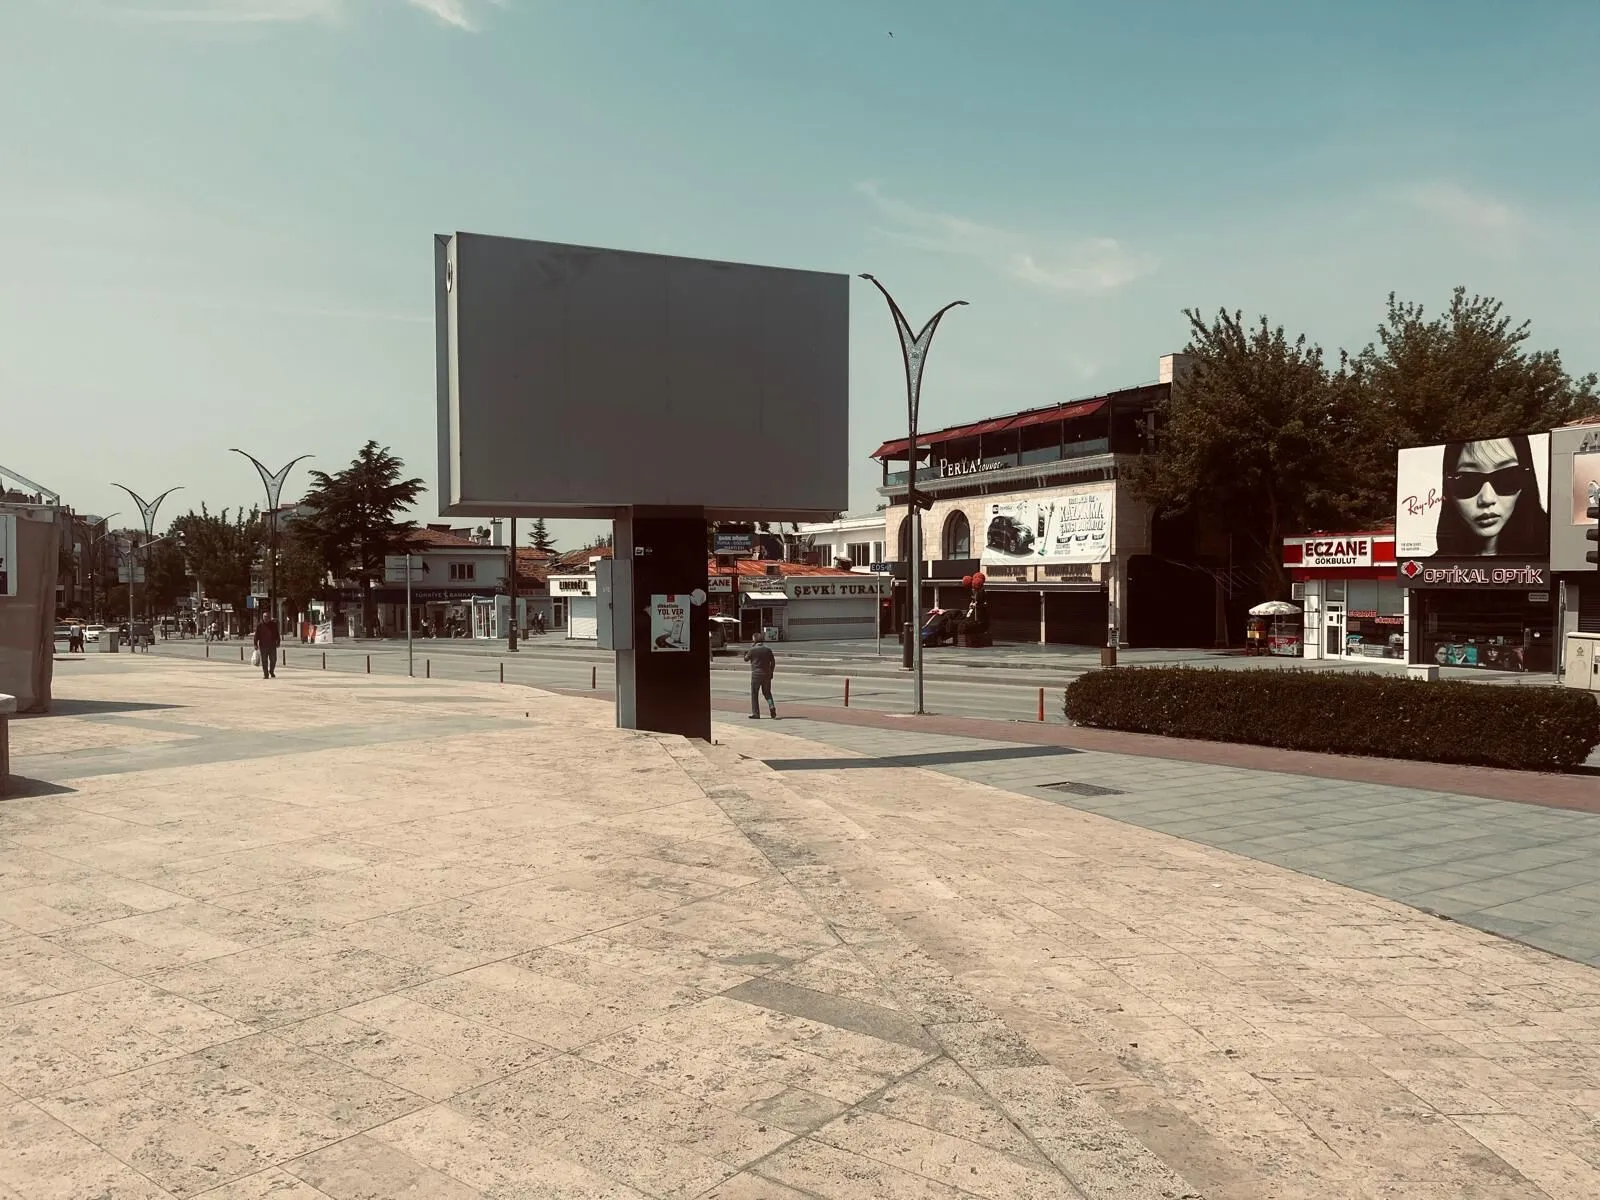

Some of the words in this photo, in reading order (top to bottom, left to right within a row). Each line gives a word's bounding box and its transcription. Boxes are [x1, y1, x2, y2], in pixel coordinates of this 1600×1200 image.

[940, 458, 977, 477] PERLA
[1402, 488, 1446, 515] Ray-Ban
[1305, 541, 1367, 557] ECZANE
[708, 578, 730, 586] ZANE
[1424, 565, 1490, 584] OPTİKAL
[1492, 565, 1543, 584] OPTİK
[794, 584, 835, 598] ŞEVKİ
[840, 584, 884, 594] TURAK
[658, 608, 670, 616] YOL
[672, 608, 684, 616] VER
